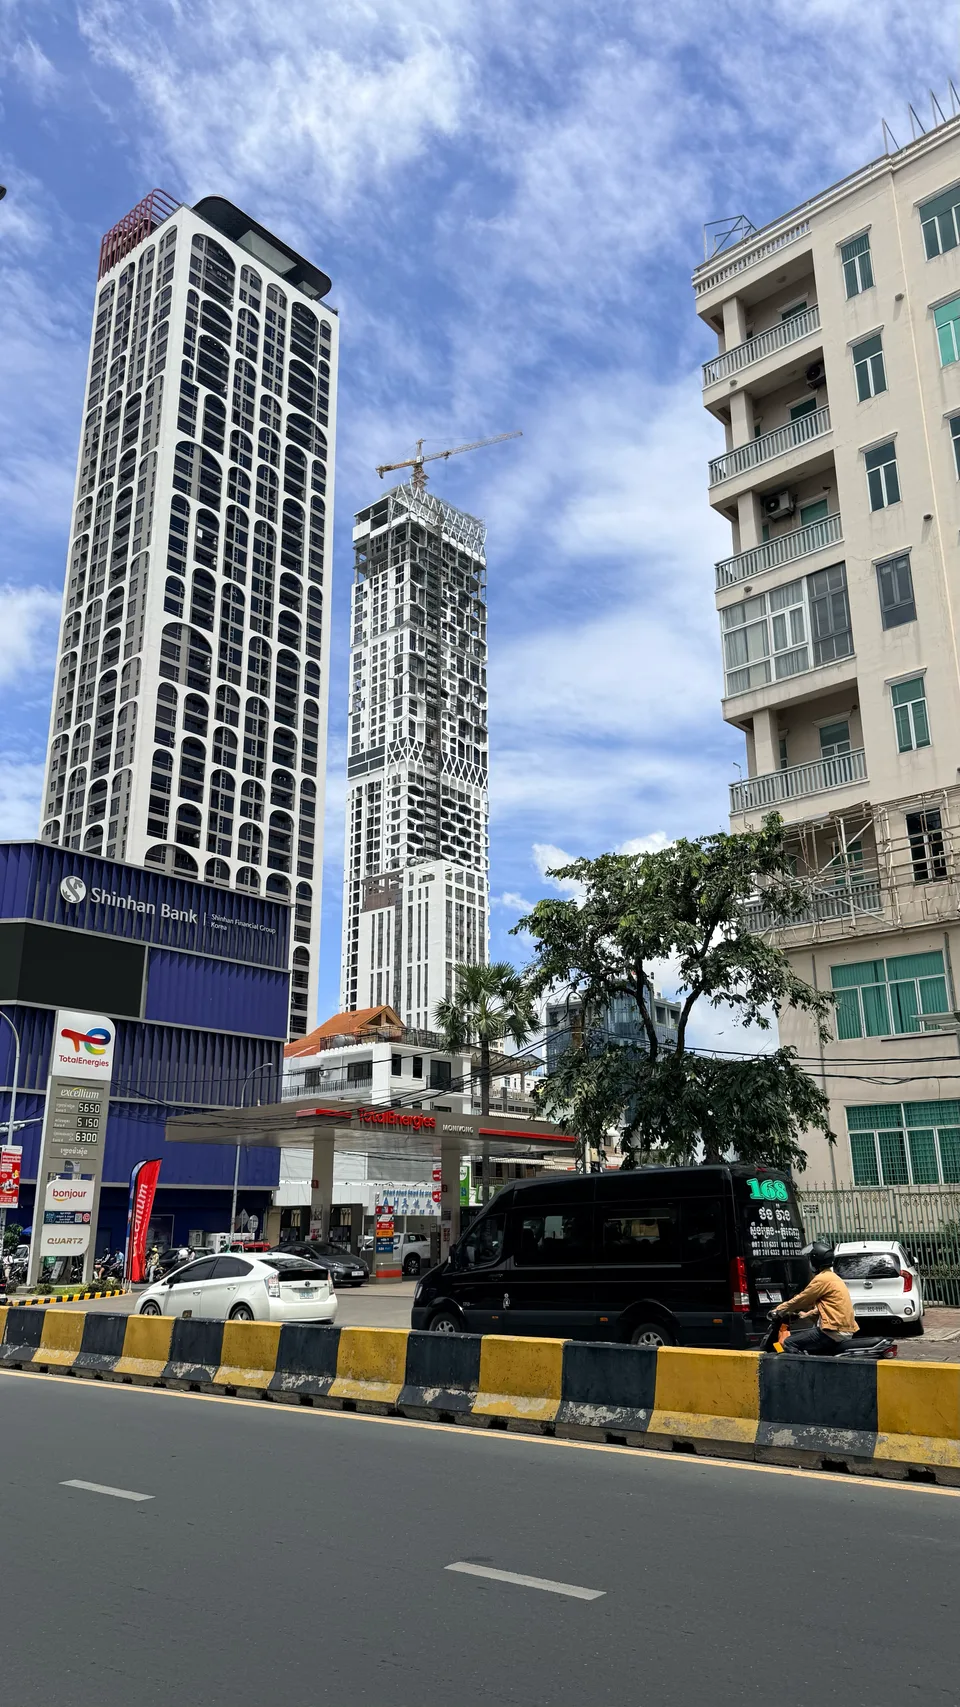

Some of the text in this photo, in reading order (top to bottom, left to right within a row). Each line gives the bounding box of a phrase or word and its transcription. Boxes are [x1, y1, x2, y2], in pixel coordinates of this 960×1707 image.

[90, 887, 198, 924] Shinhan Bank
[211, 914, 276, 934] Shinhan Financial Group
[211, 922, 228, 931] Korea
[59, 1054, 109, 1068] TotalEnergies
[60, 1088, 99, 1099] excellium
[79, 1102, 100, 1113] 5650
[78, 1118, 99, 1128] 5150
[358, 1108, 436, 1131] TotalEnergies
[442, 1124, 474, 1133] MONIVONG
[76, 1132, 97, 1142] 6300
[52, 1189, 87, 1199] bonjour
[746, 1178, 788, 1201] 168
